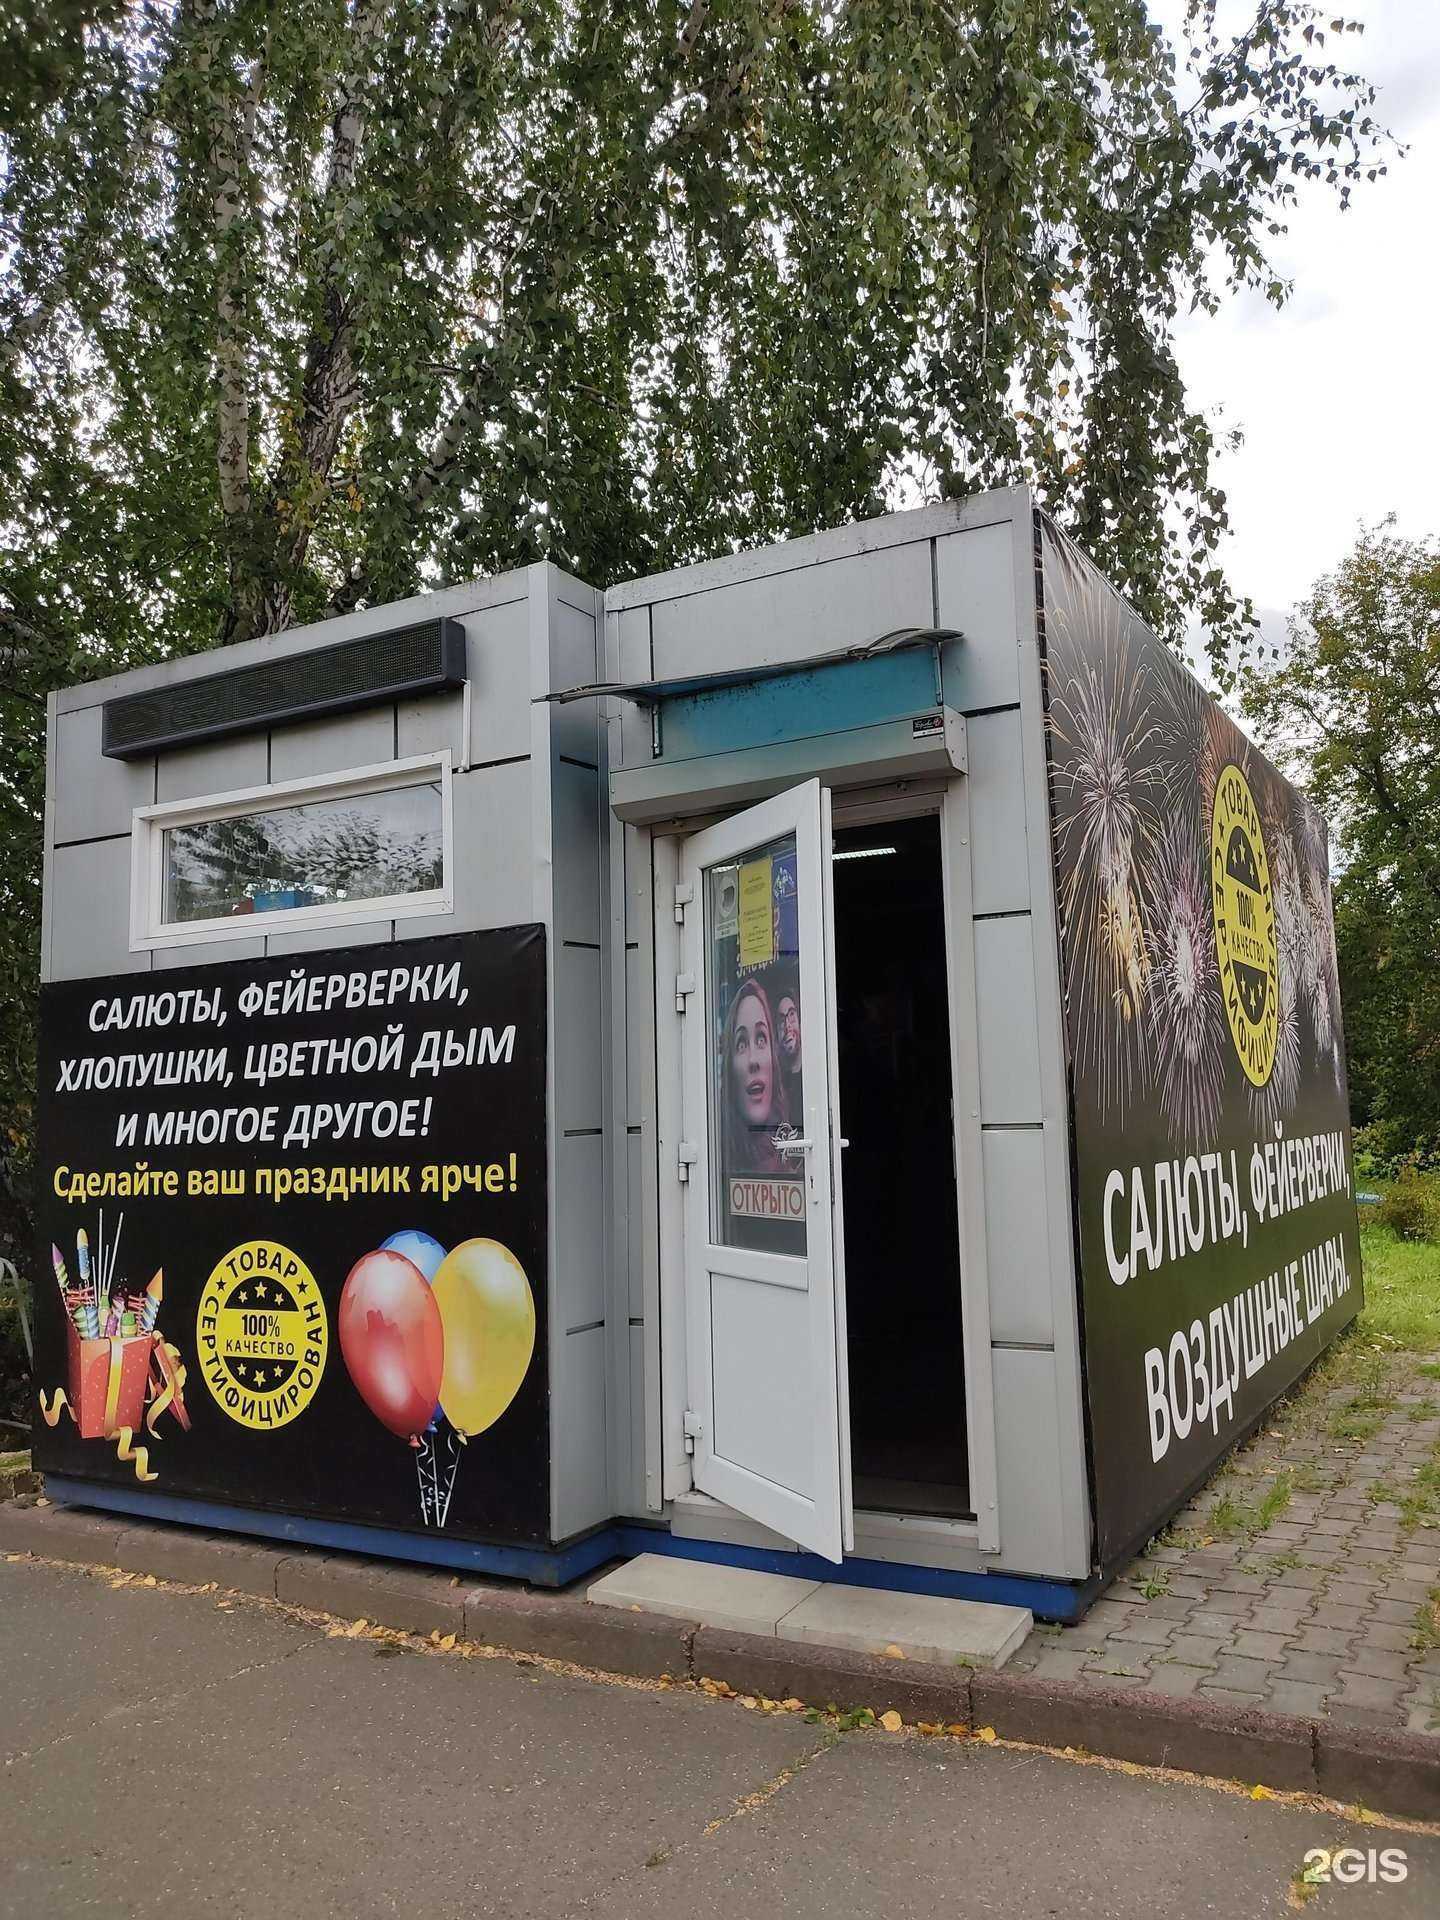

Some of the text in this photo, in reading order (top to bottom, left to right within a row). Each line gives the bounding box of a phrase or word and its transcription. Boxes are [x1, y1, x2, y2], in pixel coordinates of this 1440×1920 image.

[1221, 778, 1257, 837] ТОВАР
[1236, 888, 1256, 932] 100%
[1214, 846, 1276, 1080] СЕРТИФИЦИРОВАН
[1231, 930, 1265, 964] КАЧЕСТВО
[89, 962, 469, 1032] САЛЮТЫ, ФЕЙЕРВЕРКИ,
[55, 1023, 517, 1092] ХЛОПУШКИ, ЦВЕТНОЙ ДЫМ
[115, 1096, 433, 1149] И МНОГОЕ ДРУГОЕ!
[53, 1152, 517, 1204] Сделайте ваш праздник ярче!
[732, 1183, 802, 1216] ОТКРЫТО
[1103, 1120, 1350, 1286] САЛЮТЫ, ФЕЙЕРВЕРКИ,
[226, 1248, 298, 1279] ТОВАР
[226, 1339, 295, 1356] КАЧЕСТВО
[242, 1314, 280, 1337] 100%
[1144, 1232, 1351, 1464] ВОЗДУШНЫЕ ШАРЫ.
[202, 1296, 323, 1427] СЕРТИФИЦИРОВАН
